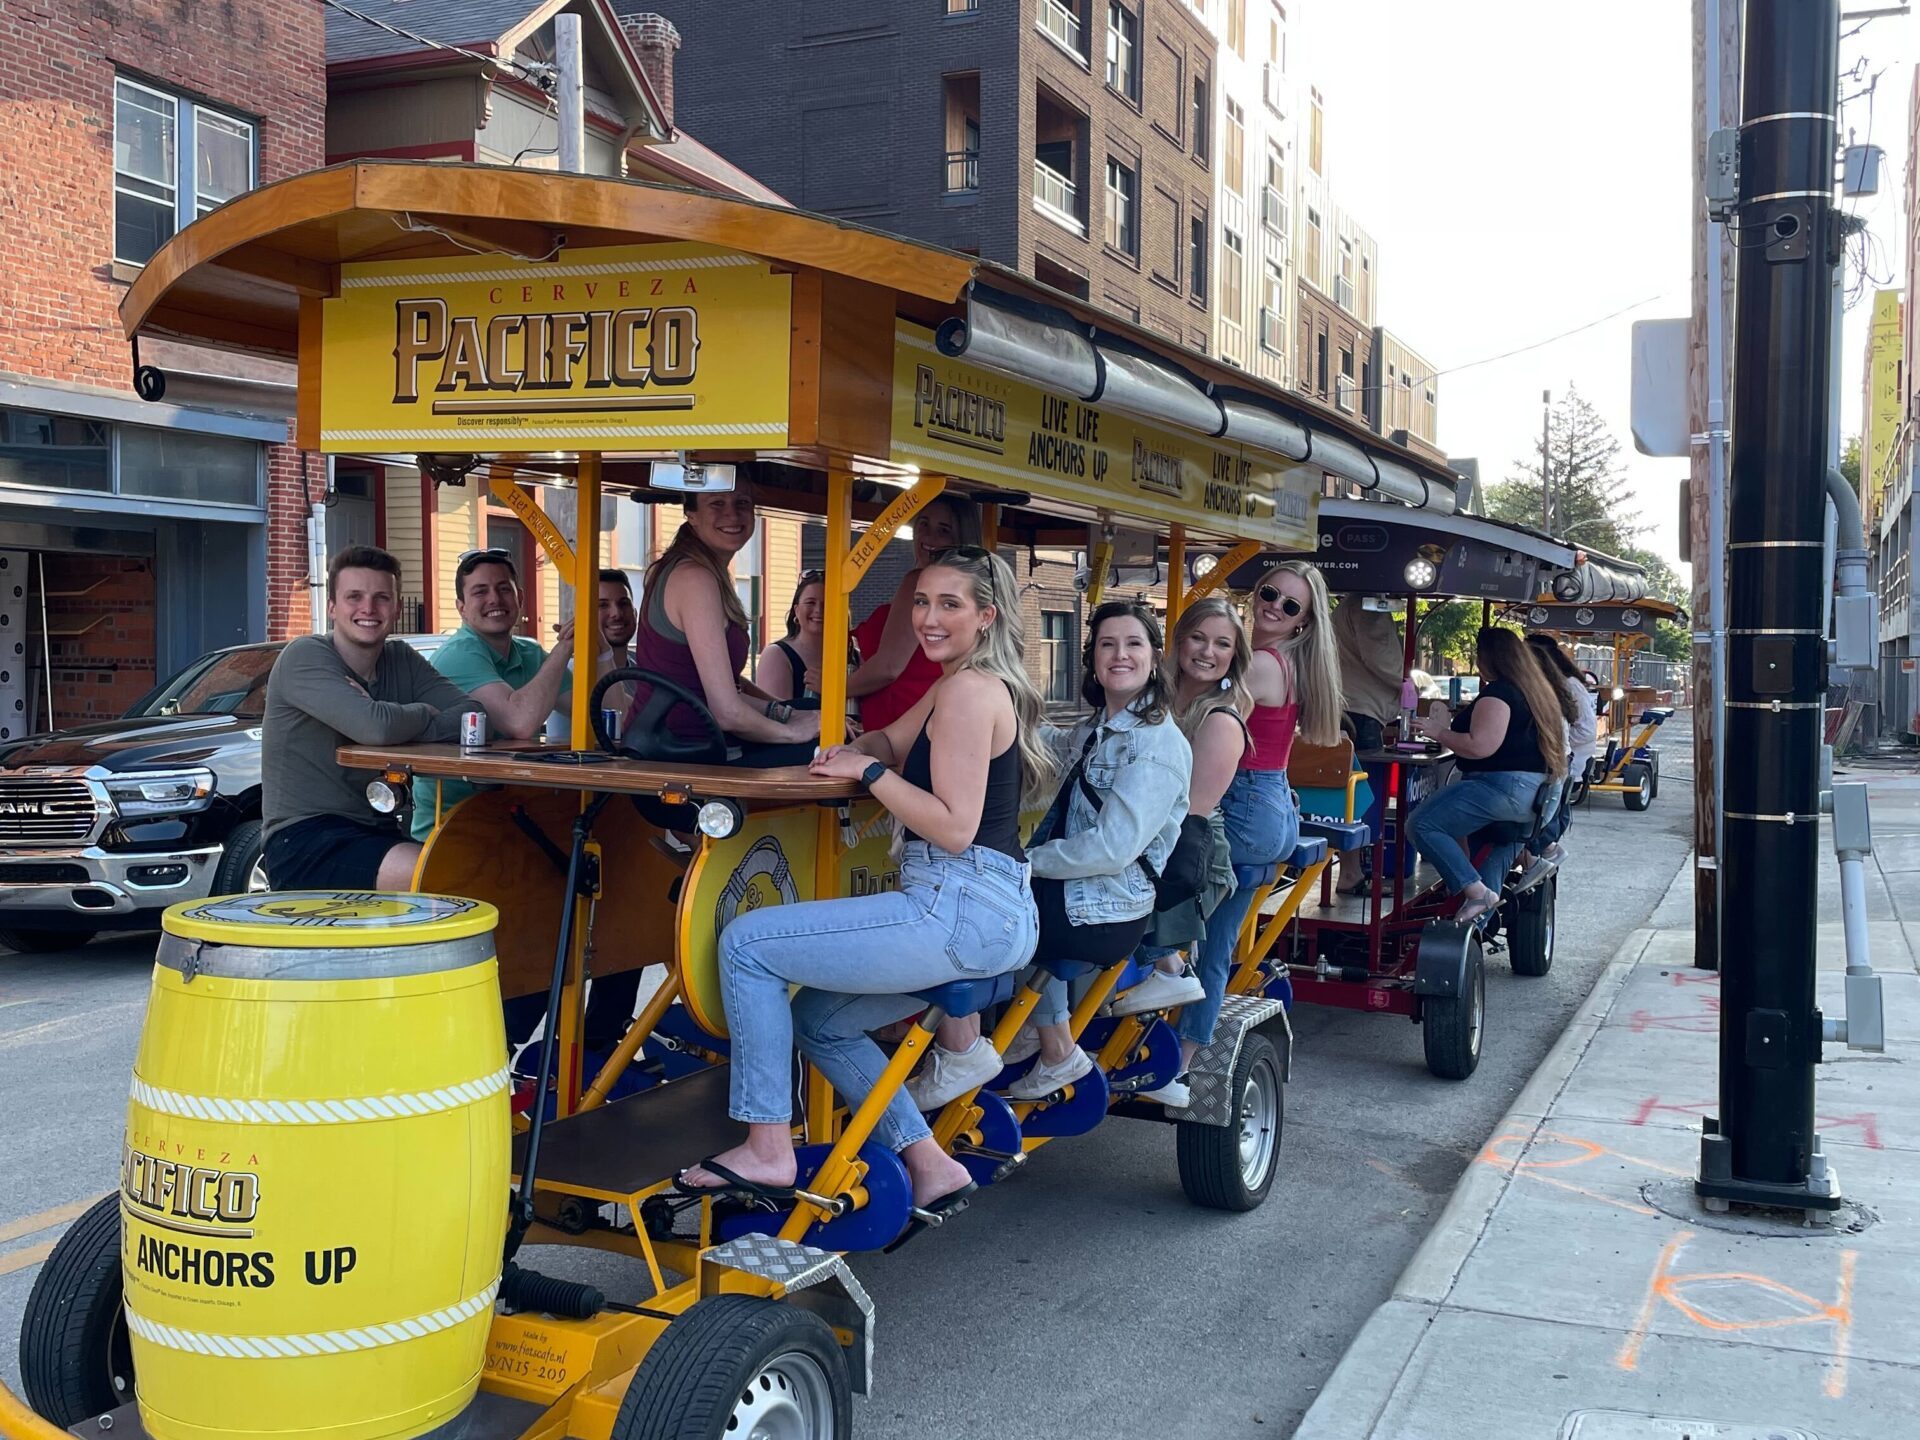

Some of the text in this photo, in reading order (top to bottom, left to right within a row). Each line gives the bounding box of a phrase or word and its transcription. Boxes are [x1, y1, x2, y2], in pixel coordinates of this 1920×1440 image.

[489, 276, 698, 304] CERVEZA
[457, 417, 484, 426] Discover
[1042, 394, 1100, 443] LIVE LIFE
[1028, 431, 1108, 482] ANCHORS UP
[1212, 451, 1251, 487] LIVE LIFE
[507, 489, 528, 513] Het
[1204, 481, 1242, 516] ANCHORS
[852, 541, 875, 570] Het
[0, 802, 39, 813] AM
[133, 1131, 259, 1166] CERVEZA
[137, 1233, 275, 1289] ANCHORS
[305, 1246, 357, 1286] UP
